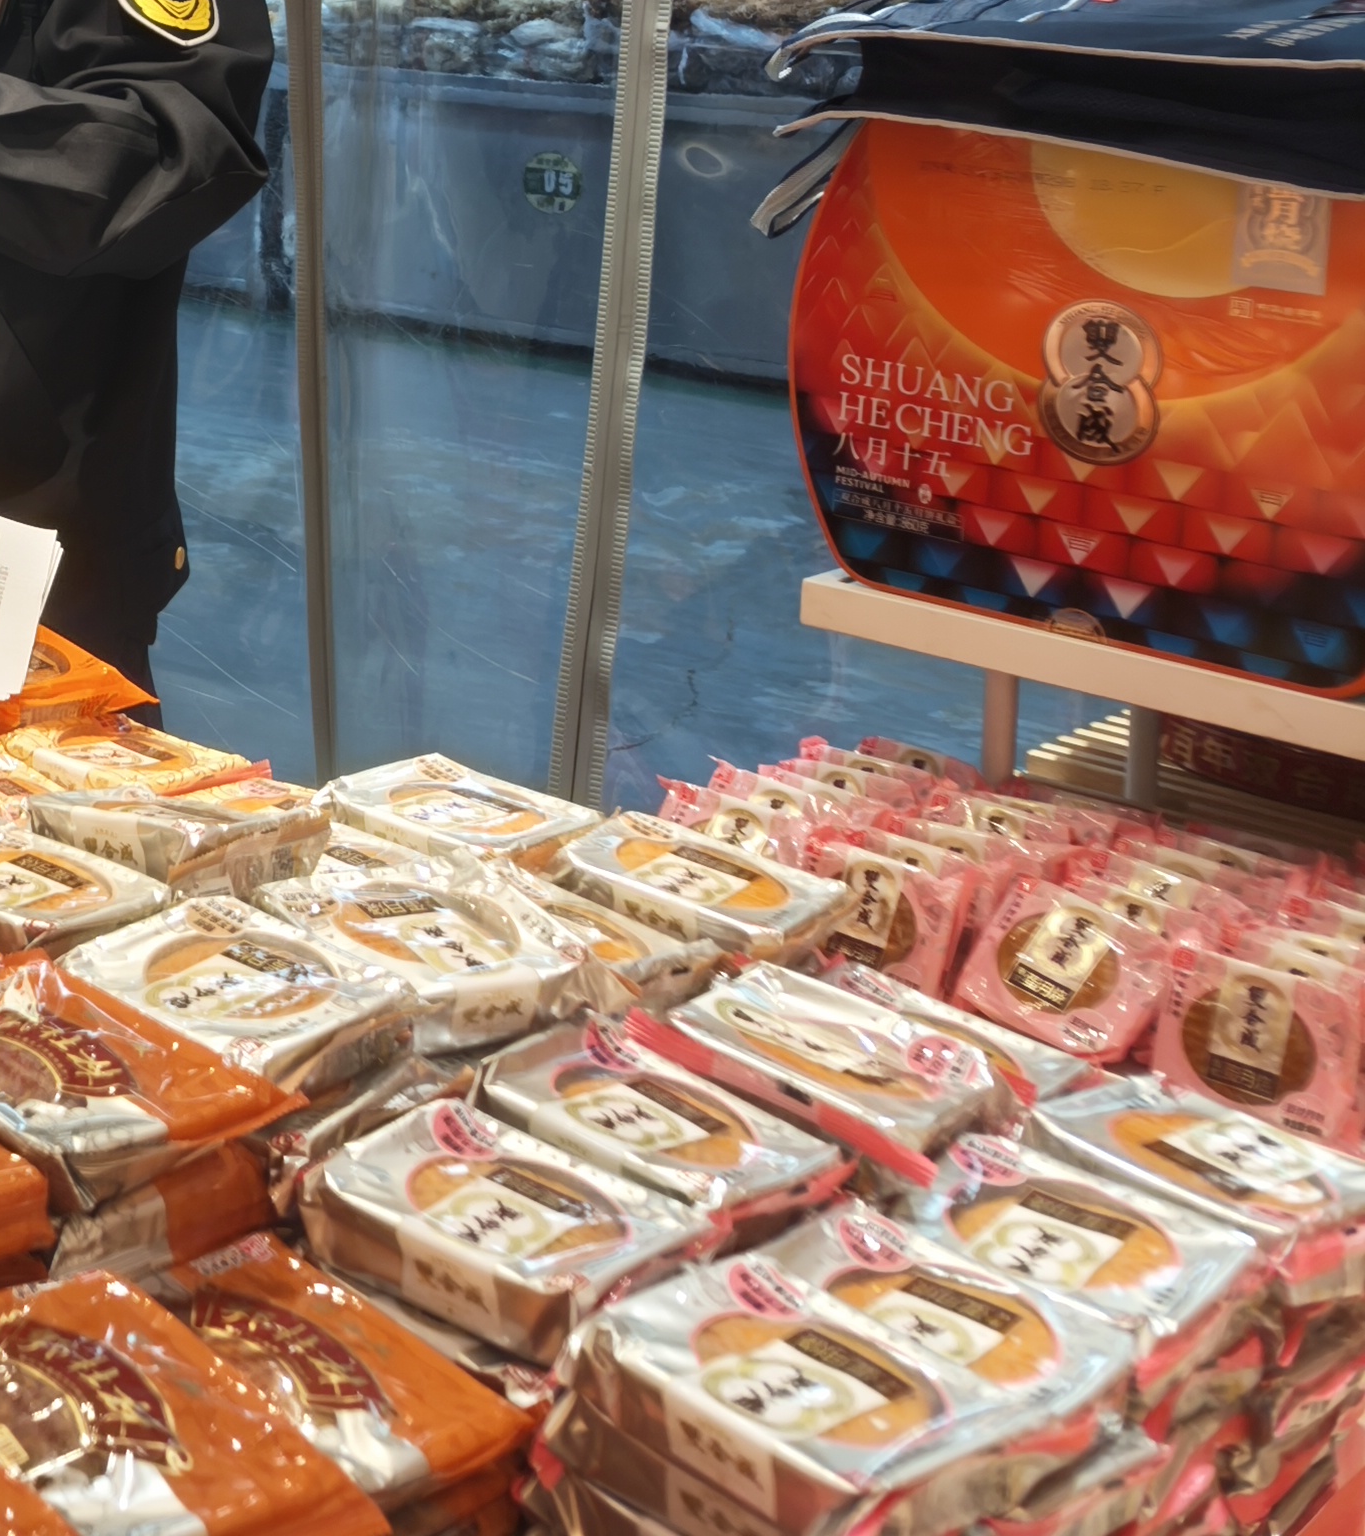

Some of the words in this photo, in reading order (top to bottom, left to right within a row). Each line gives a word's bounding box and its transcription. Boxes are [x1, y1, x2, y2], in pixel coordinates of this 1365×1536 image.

[840, 353, 1016, 413] SHUANG
[1072, 319, 1124, 455] 雙合成
[832, 431, 952, 478] 八月十五
[835, 465, 911, 489] MID-AUTUMN
[835, 475, 885, 494] FESTIVAL
